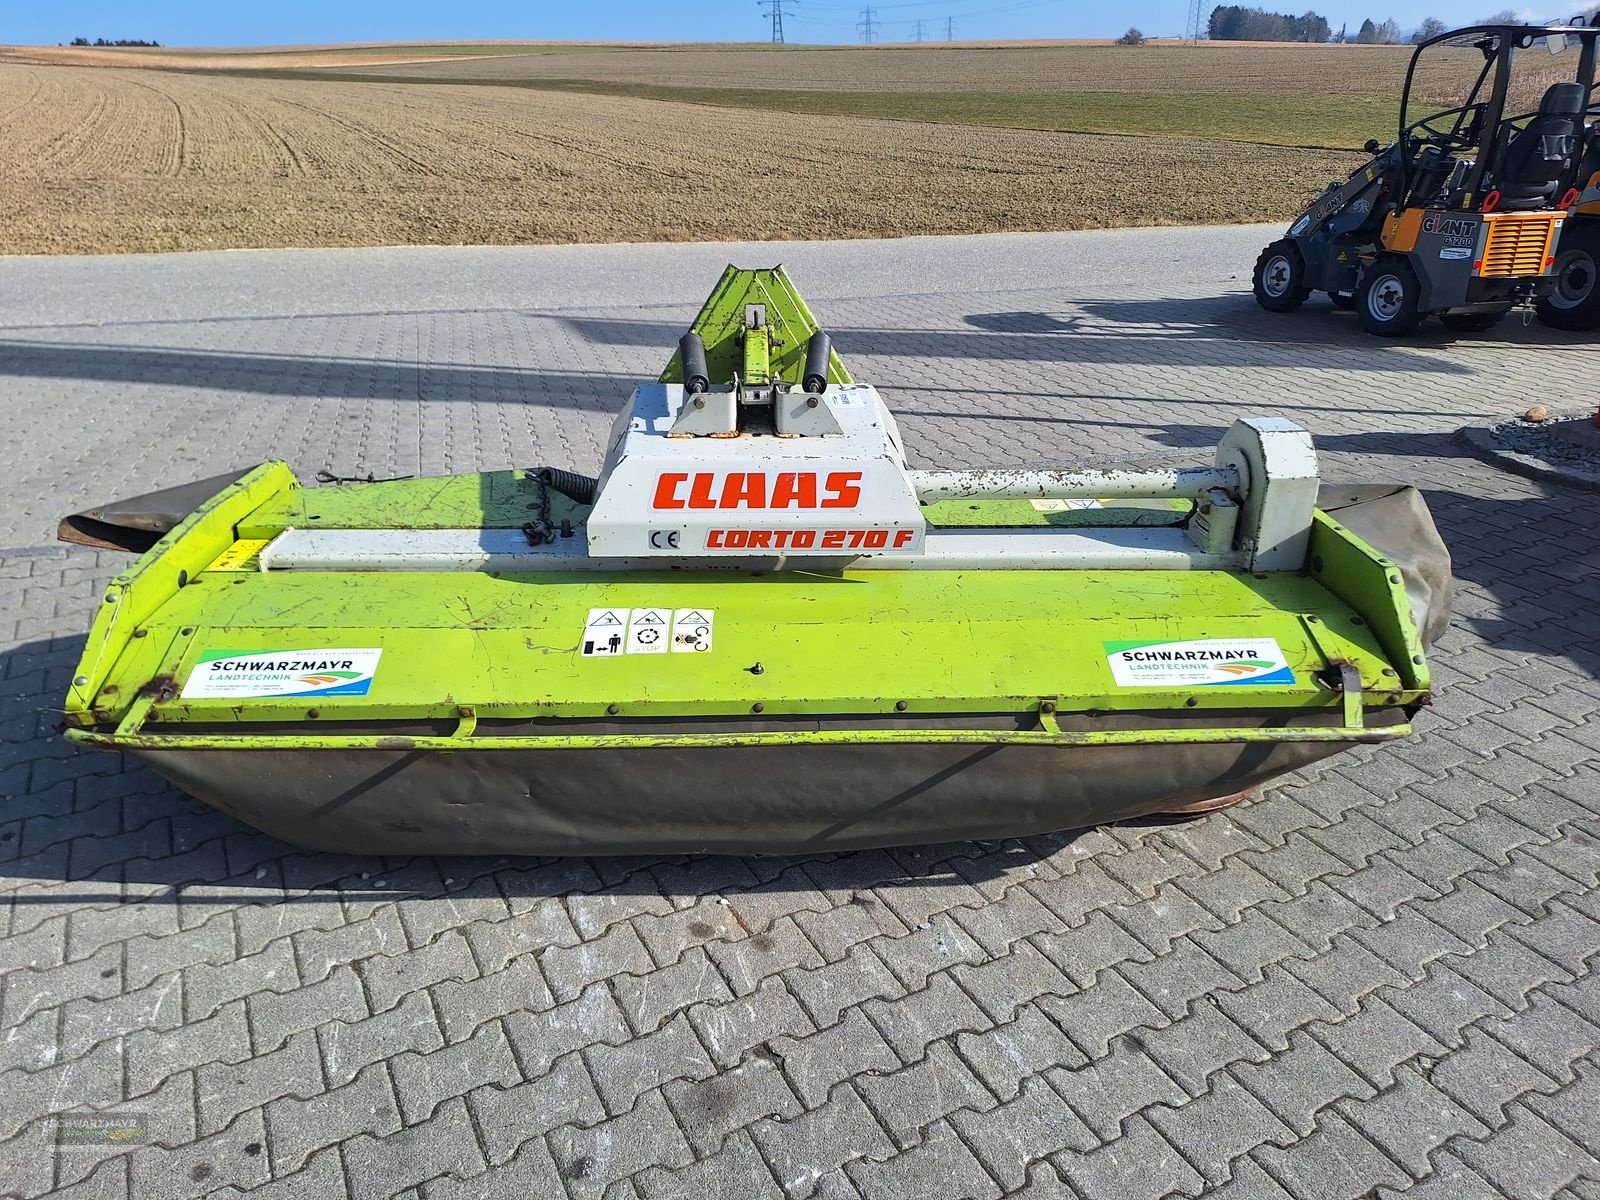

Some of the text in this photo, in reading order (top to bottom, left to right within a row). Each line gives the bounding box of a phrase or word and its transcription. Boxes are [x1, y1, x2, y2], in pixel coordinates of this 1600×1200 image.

[1442, 235, 1473, 248] G1200
[652, 472, 863, 510] CLAAS
[650, 531, 679, 549] CE
[706, 530, 914, 549] CORTO 270 F
[1122, 650, 1259, 661] SCHWARZMAYR
[210, 660, 353, 671] SCHWARZMAYR
[1129, 663, 1209, 671] LANDTECHNIK
